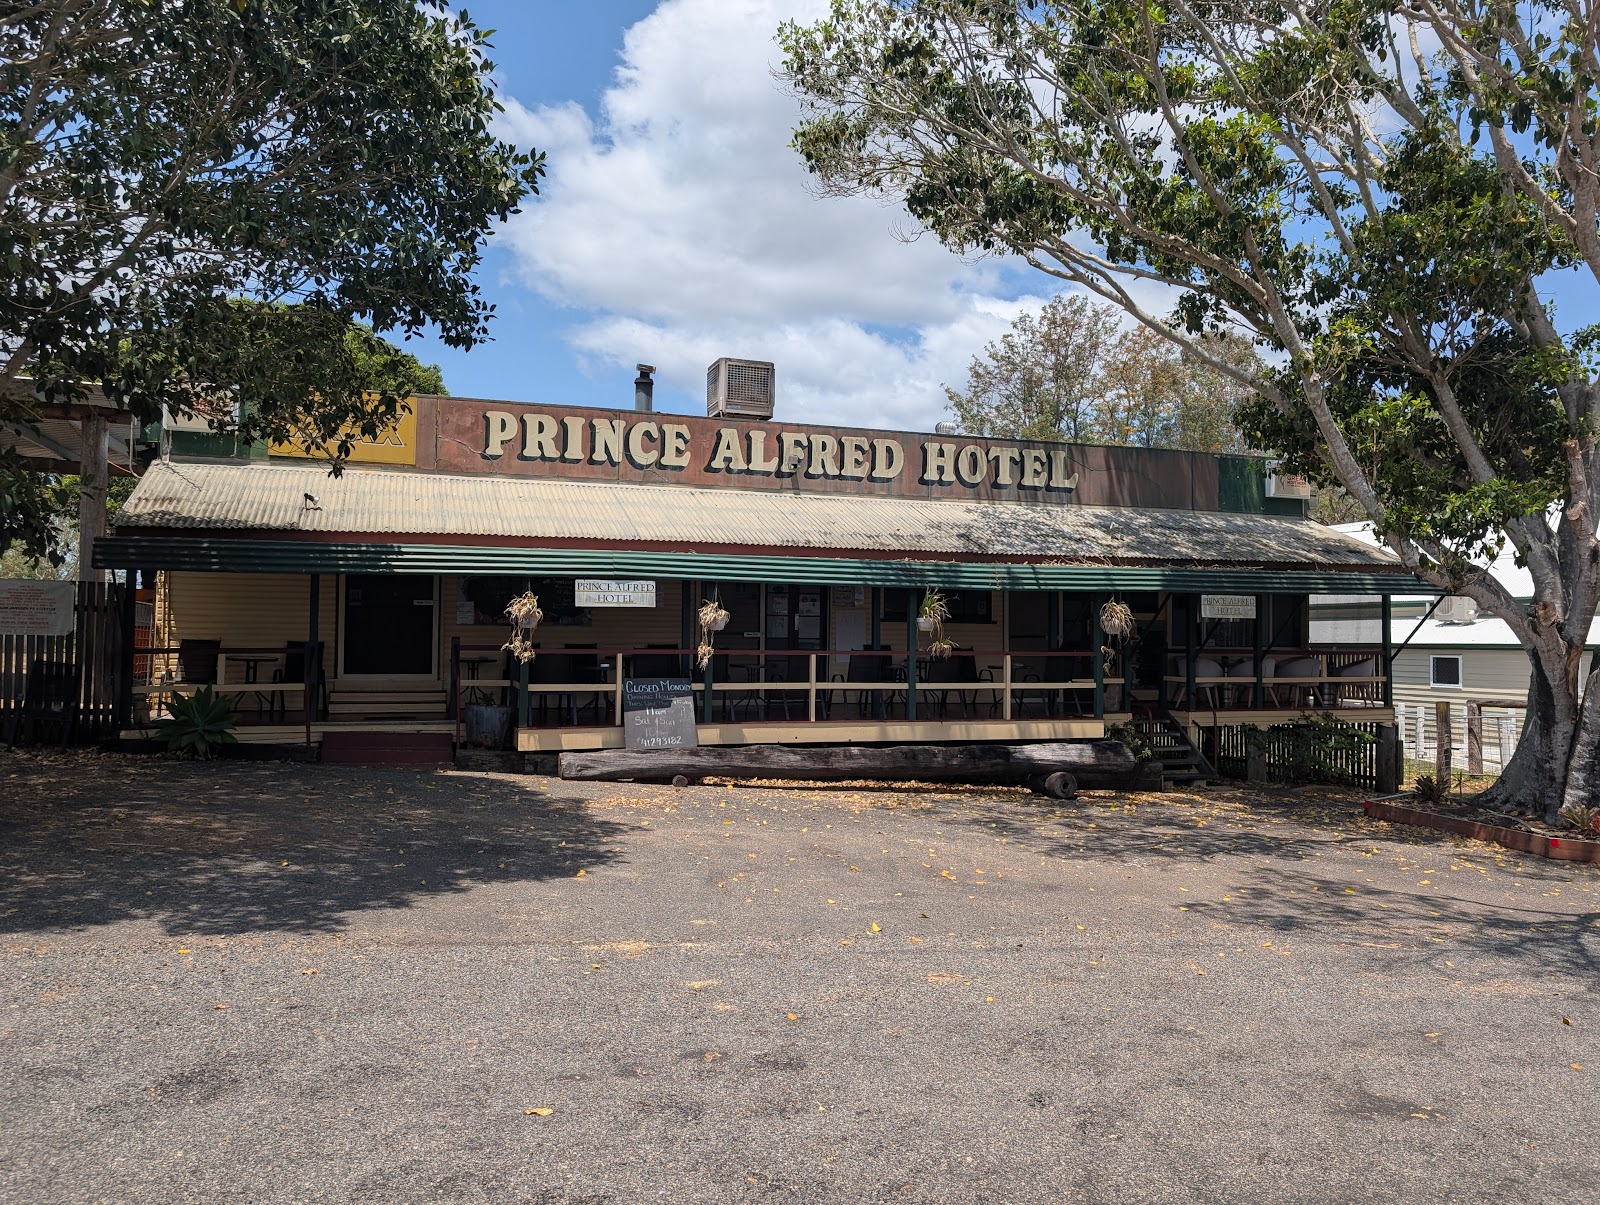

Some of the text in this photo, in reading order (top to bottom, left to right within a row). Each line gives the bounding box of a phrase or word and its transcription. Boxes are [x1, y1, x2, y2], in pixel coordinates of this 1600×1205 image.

[484, 410, 1079, 489] PRINCE ALFRED HOTEL
[577, 582, 655, 592] PRINCE ALFRED
[597, 594, 636, 603] HOTEL
[1216, 607, 1243, 615] HOTEL
[634, 715, 651, 725] Sat
